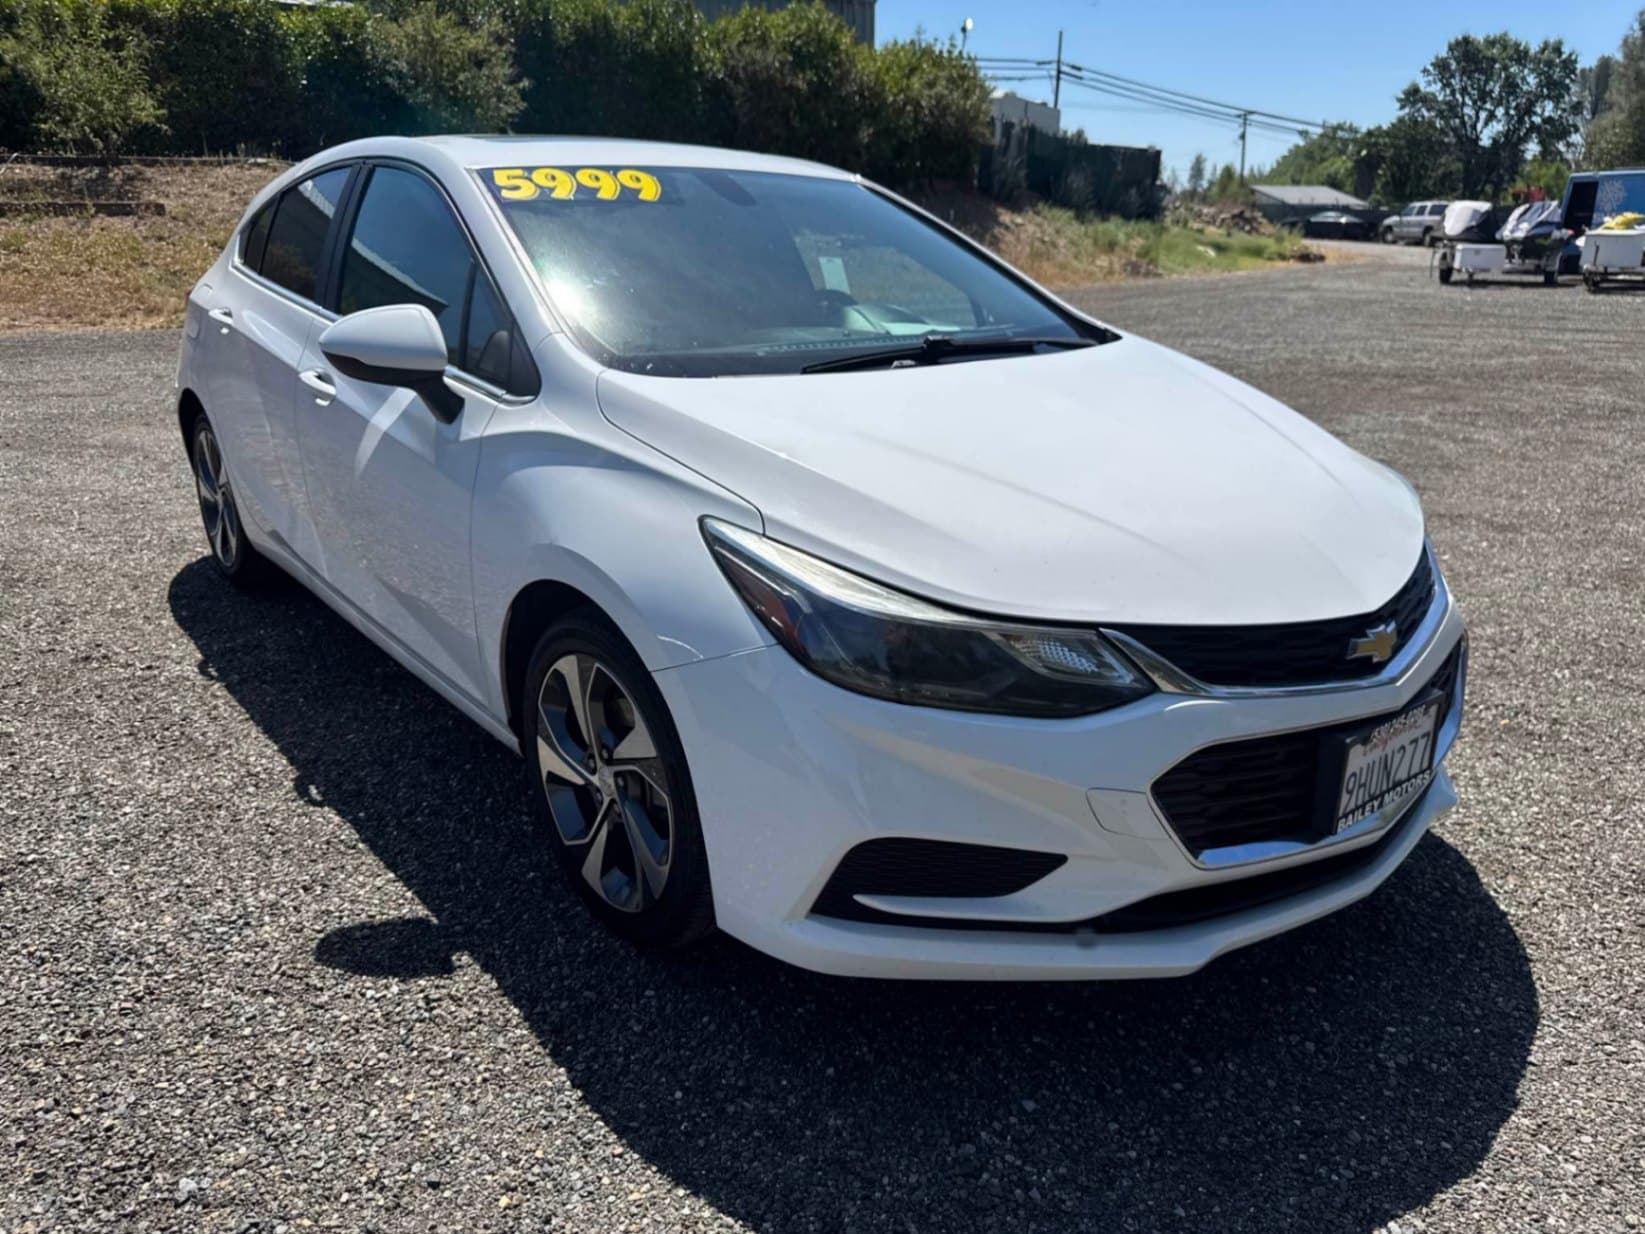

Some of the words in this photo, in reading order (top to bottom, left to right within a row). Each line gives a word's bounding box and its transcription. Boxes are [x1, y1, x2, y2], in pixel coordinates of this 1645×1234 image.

[493, 167, 662, 201] 5999
[1339, 798, 1382, 831] BAILEY
[1383, 769, 1432, 804] MOTORS
[1343, 732, 1431, 815] 9HUN277
